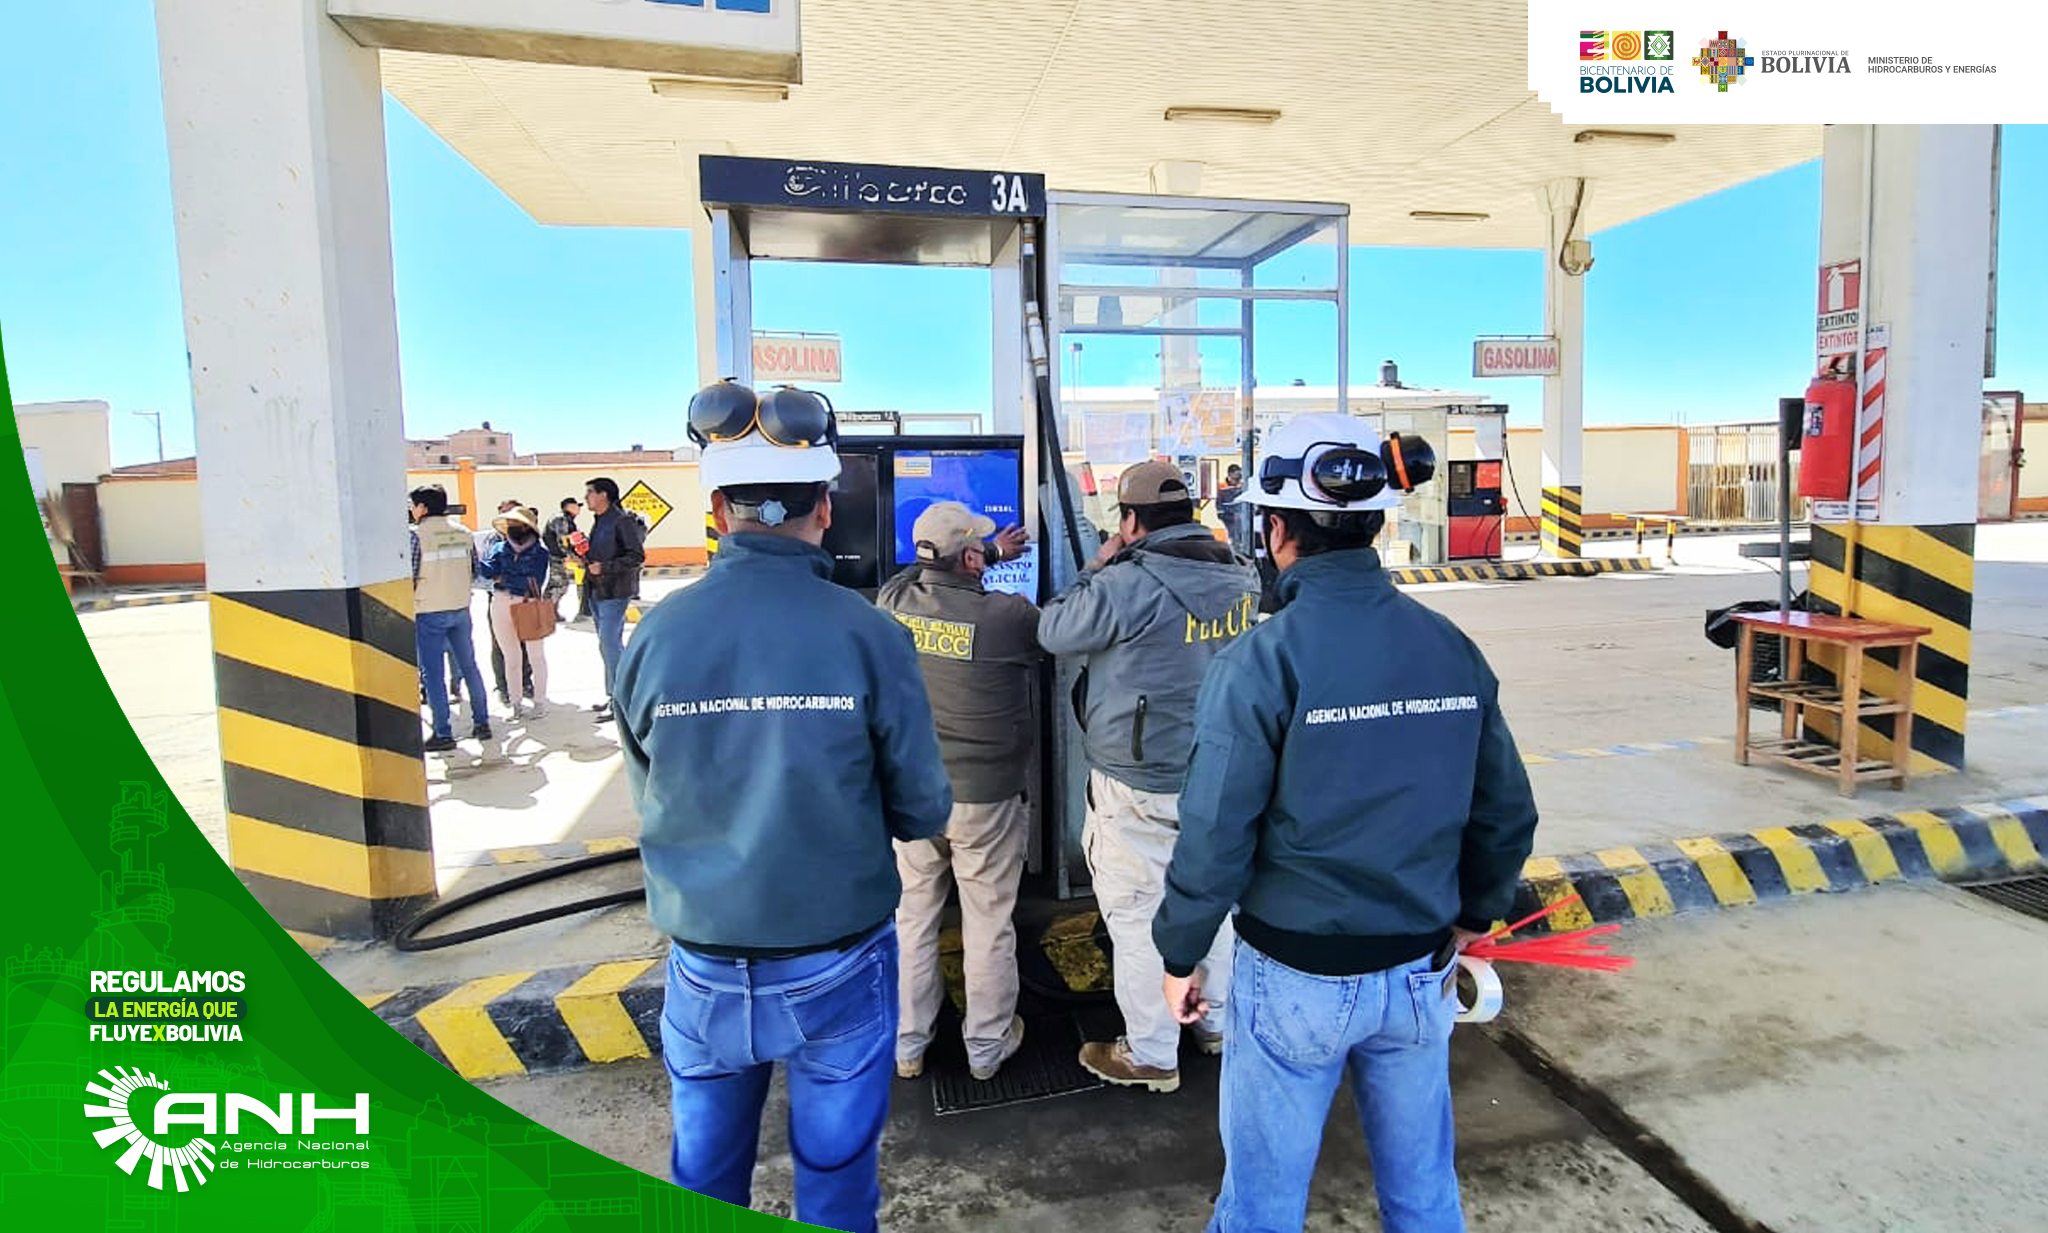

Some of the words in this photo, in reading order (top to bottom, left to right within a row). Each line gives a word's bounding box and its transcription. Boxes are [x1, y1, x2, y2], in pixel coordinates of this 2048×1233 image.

[991, 174, 1028, 213] 3A
[1819, 312, 1859, 328] EXTINTO
[753, 345, 837, 373] ASOLINA
[1484, 347, 1558, 369] GASOLINA
[699, 698, 750, 714] NACIONAL
[751, 697, 765, 711] DE
[766, 696, 855, 711] HIDROCARBUROS
[1305, 707, 1348, 724] AGENCIA
[1348, 703, 1391, 721] NACIONAL
[1391, 701, 1404, 716] DE
[1405, 696, 1477, 714] HIDROCARBUROS
